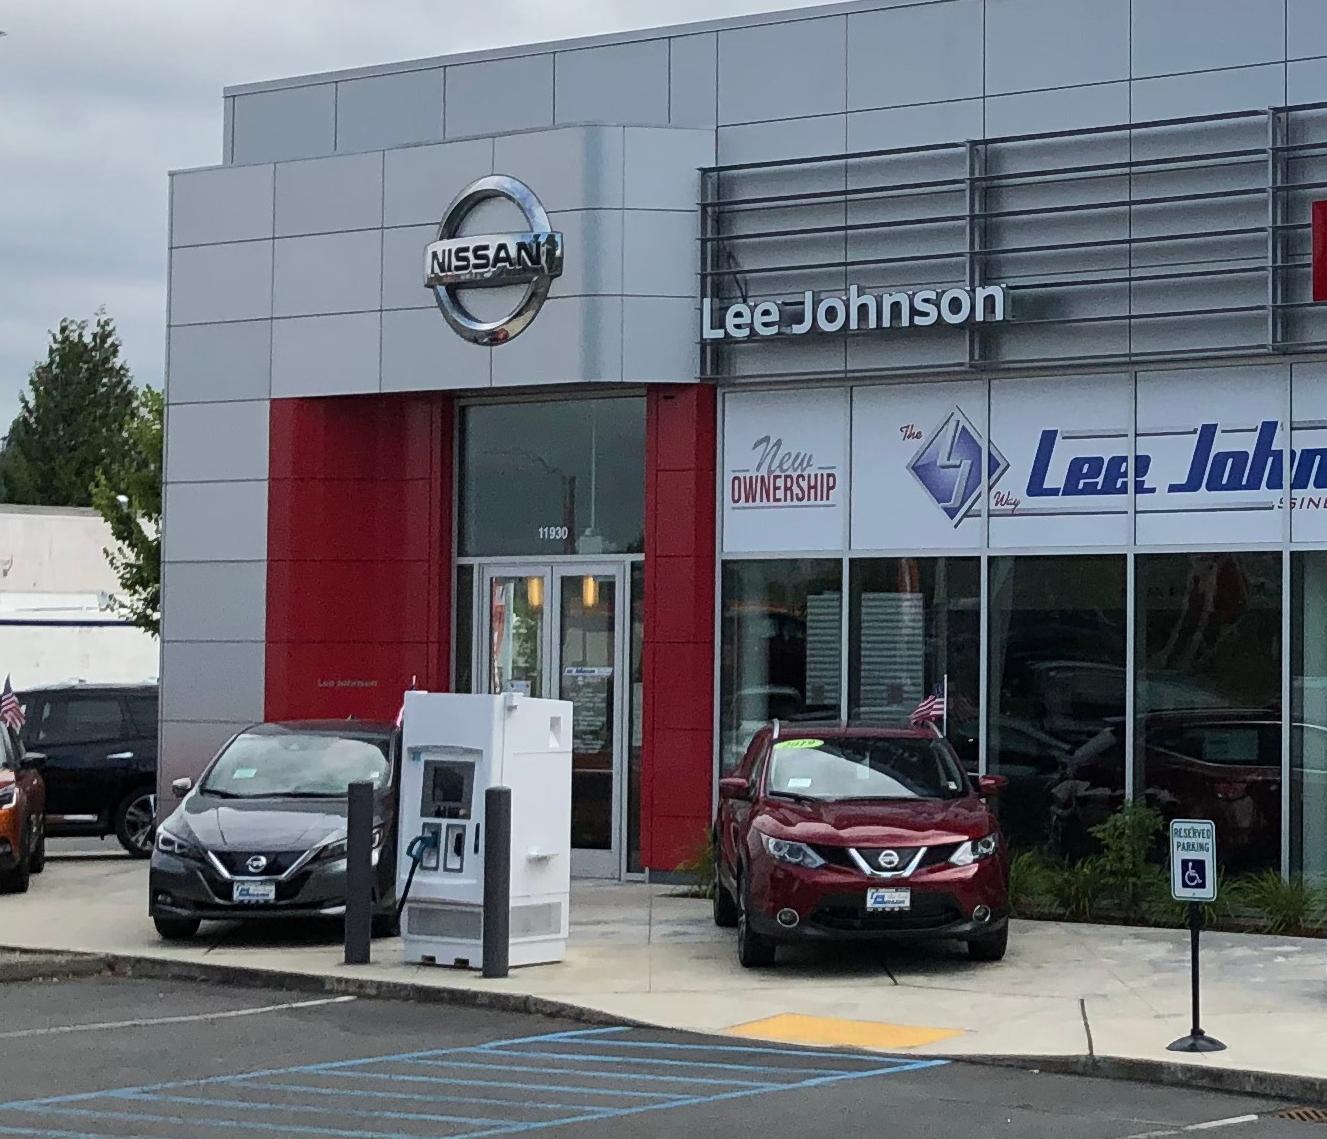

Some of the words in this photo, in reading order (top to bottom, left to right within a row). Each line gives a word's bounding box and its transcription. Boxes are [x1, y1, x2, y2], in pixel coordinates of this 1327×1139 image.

[430, 241, 543, 276] NISSAN
[702, 297, 781, 339] Lee
[791, 284, 1004, 335] Johnson
[899, 424, 923, 441] The
[752, 435, 814, 476] New
[1026, 428, 1157, 498] Lee
[731, 472, 837, 504] OWNERSHIP
[993, 490, 1021, 514] Way
[538, 526, 569, 540] 11930
[1173, 827, 1211, 840] RESERVED
[1176, 841, 1210, 853] PARKING
